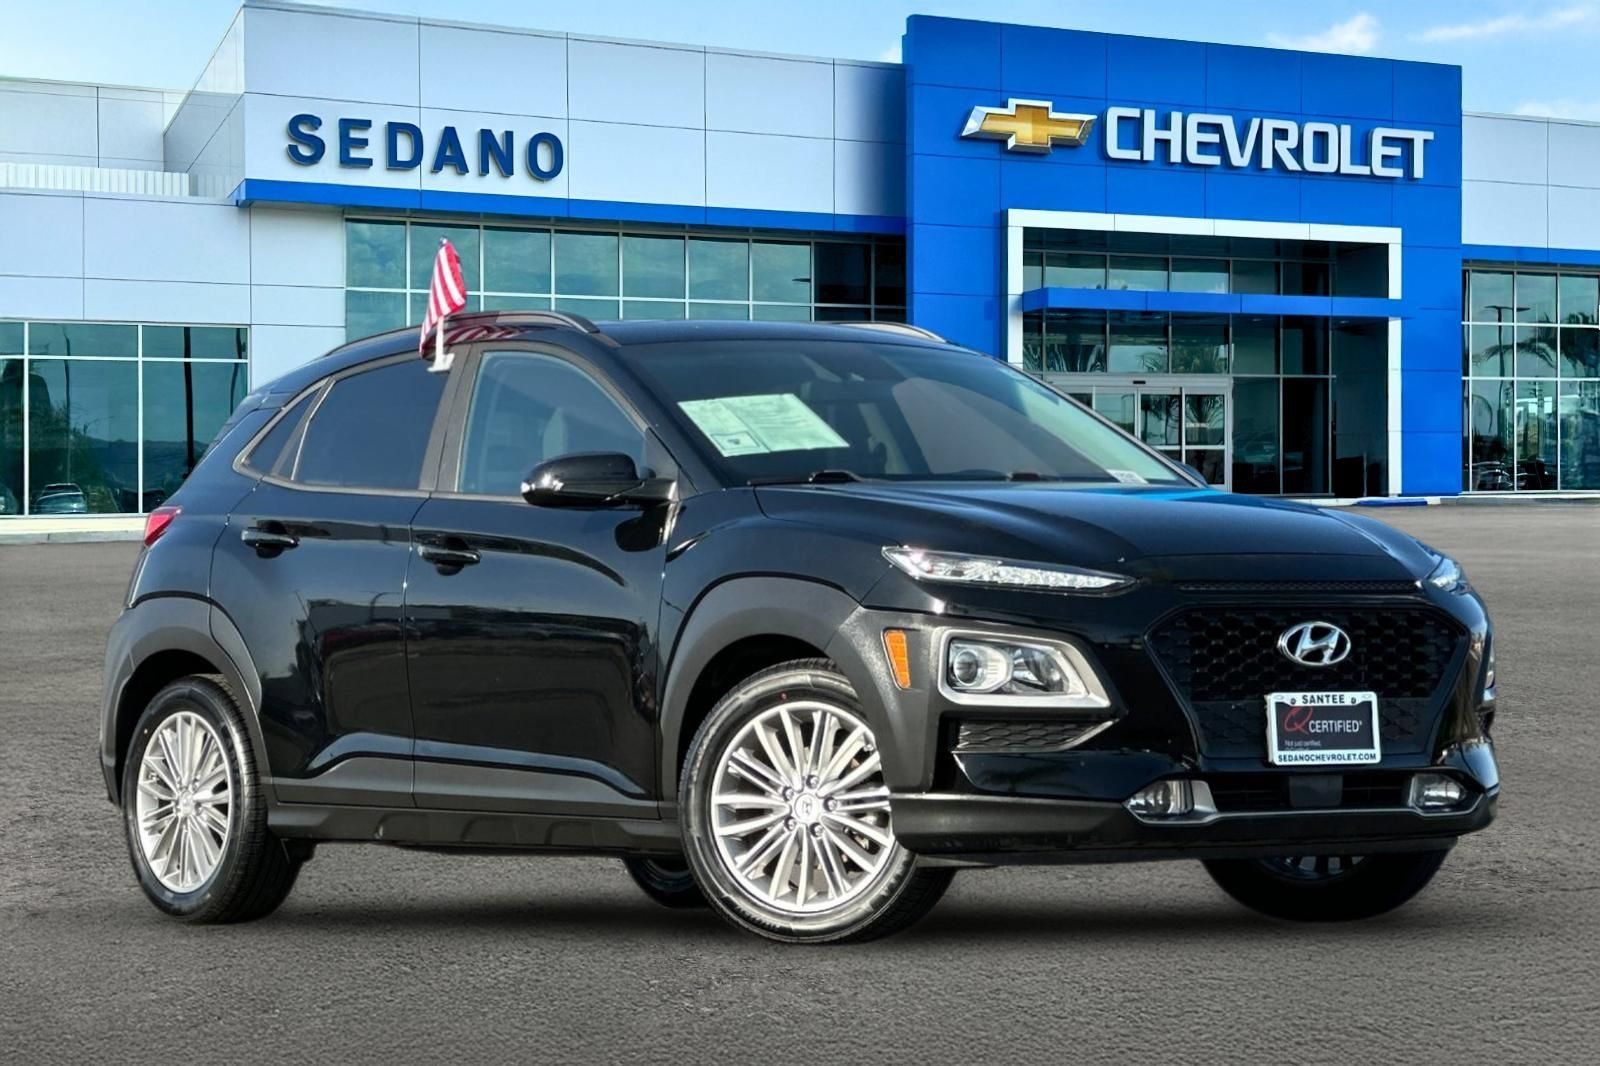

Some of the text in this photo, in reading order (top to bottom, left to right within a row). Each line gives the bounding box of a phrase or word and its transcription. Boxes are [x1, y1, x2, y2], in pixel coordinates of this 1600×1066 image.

[287, 113, 564, 181] SEDANO
[1106, 106, 1434, 179] CHEVROLET
[1302, 694, 1345, 704] SANTEE
[1278, 752, 1377, 763] SEDANOCHEVROLET.COM
